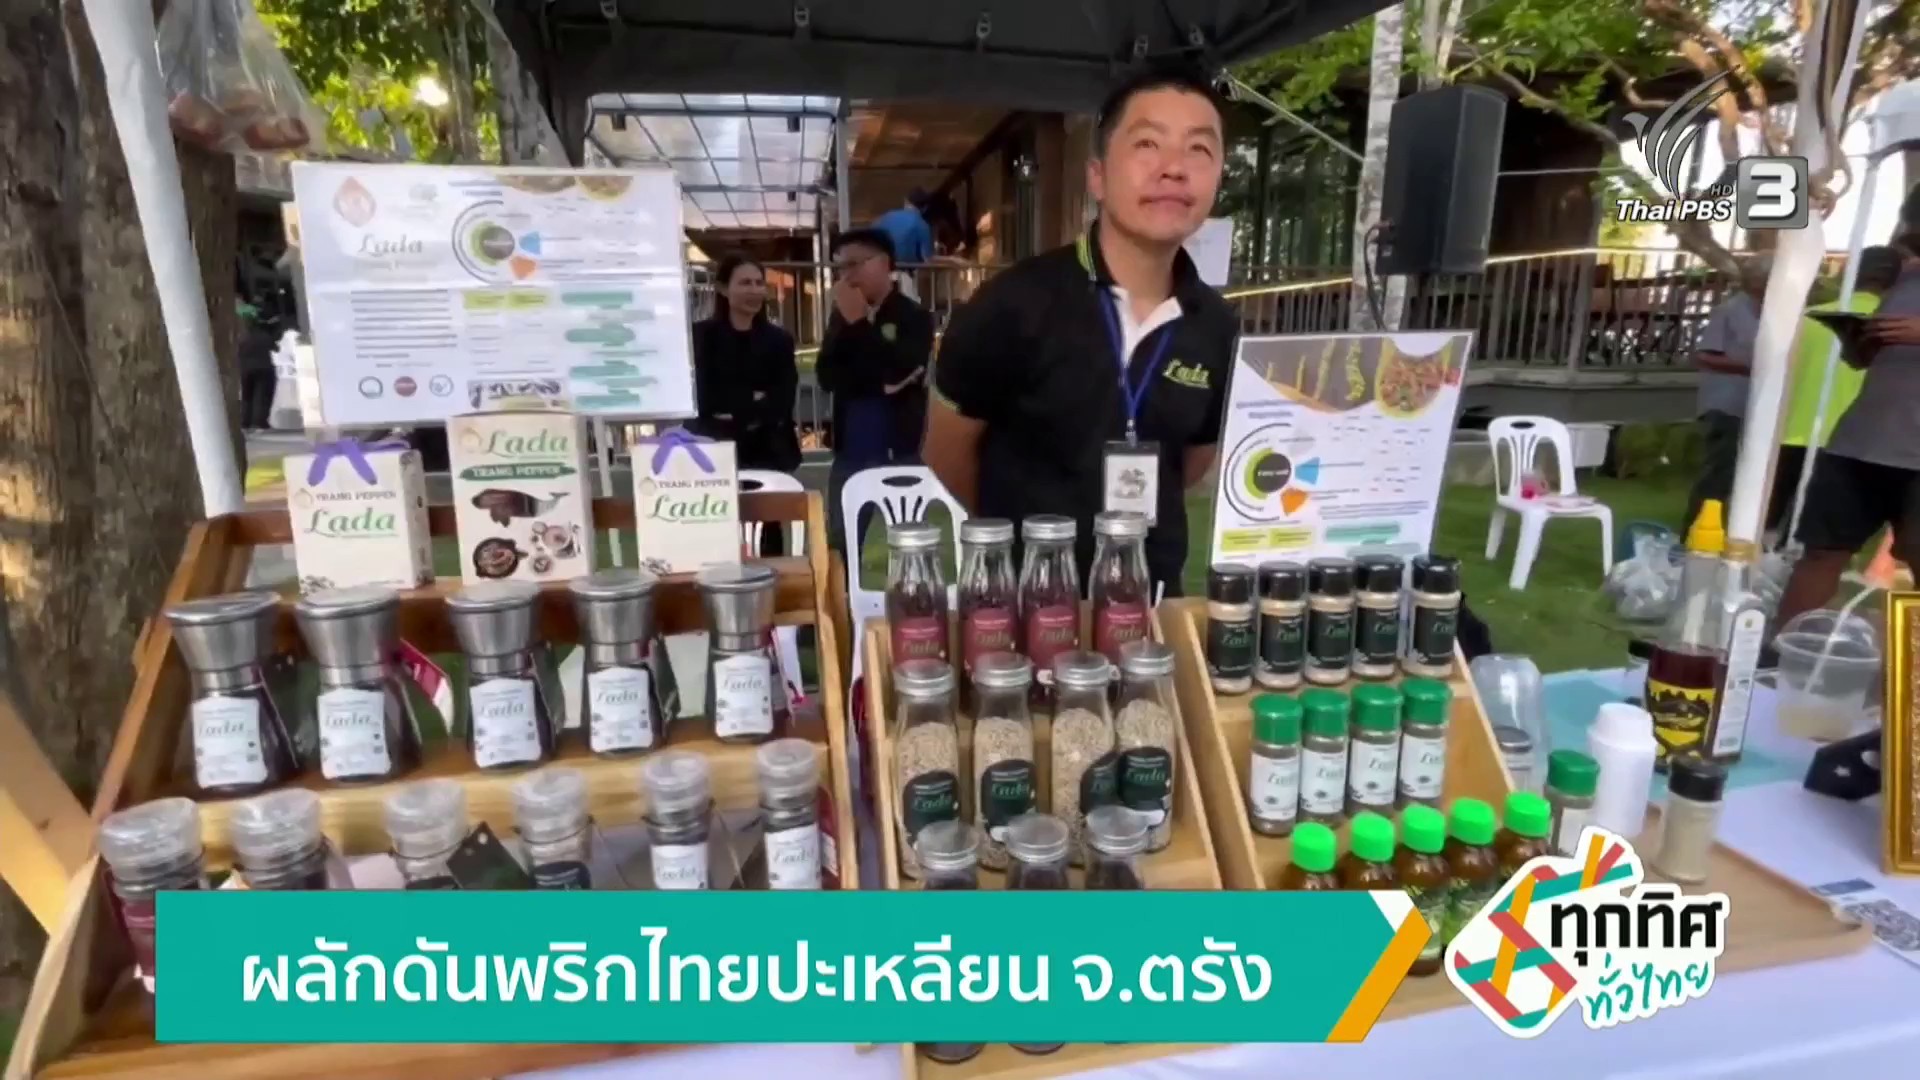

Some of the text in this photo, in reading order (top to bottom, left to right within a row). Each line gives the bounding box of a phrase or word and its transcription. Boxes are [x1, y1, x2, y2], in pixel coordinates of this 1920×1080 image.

[483, 429, 569, 456] Lada
[303, 507, 396, 537] Lada
[648, 493, 729, 522] Lada
